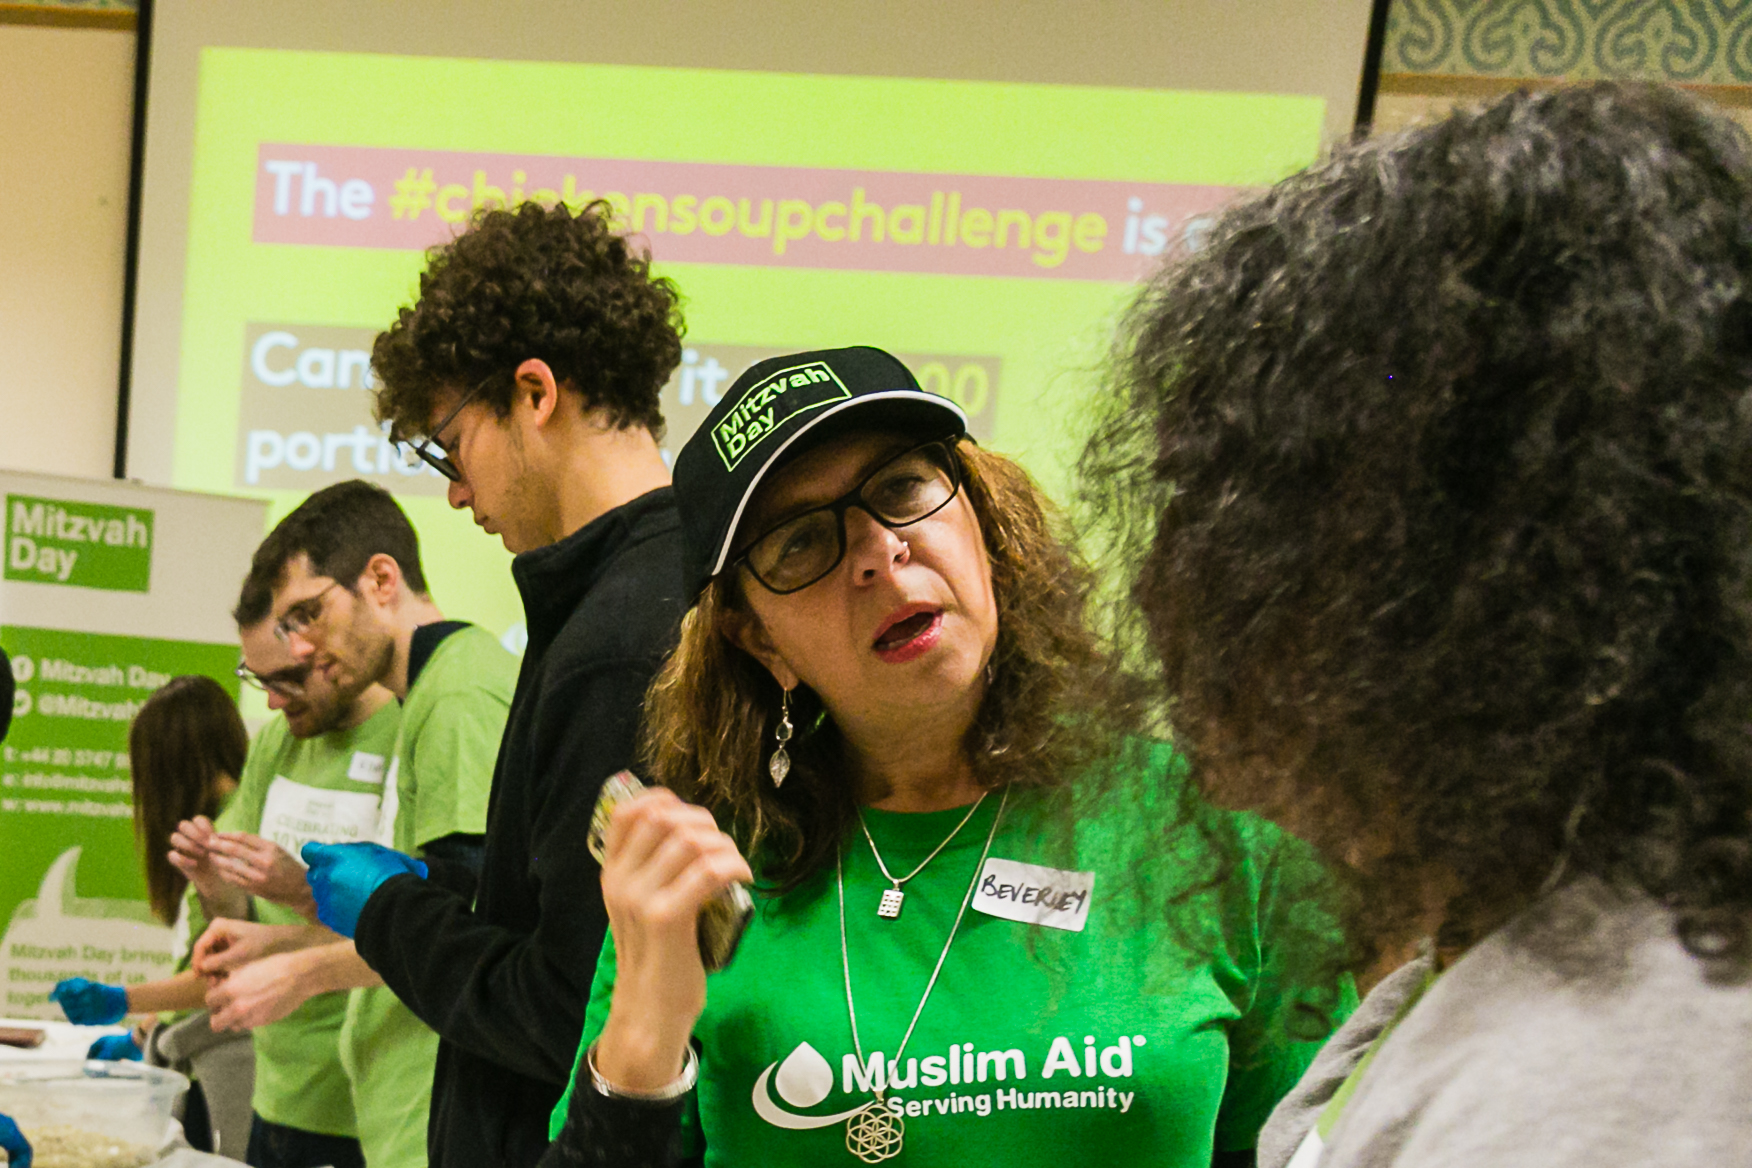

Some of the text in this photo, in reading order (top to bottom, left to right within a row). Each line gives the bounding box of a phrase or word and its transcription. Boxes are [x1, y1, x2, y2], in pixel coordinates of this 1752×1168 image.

[265, 160, 375, 220] The
[1122, 196, 1169, 256] is
[719, 367, 831, 443] Mitzvah
[726, 406, 775, 459] Day
[11, 501, 149, 548] Mitzvah
[10, 536, 78, 581] Day
[40, 657, 172, 689] Mitzvah Day
[38, 692, 146, 721] @Mitzvah
[10, 944, 77, 960] Mitzvah
[82, 945, 114, 965] Day
[103, 969, 122, 984] of
[842, 1042, 1028, 1094] Muslim
[886, 1085, 1135, 1118] Serving Humanity
